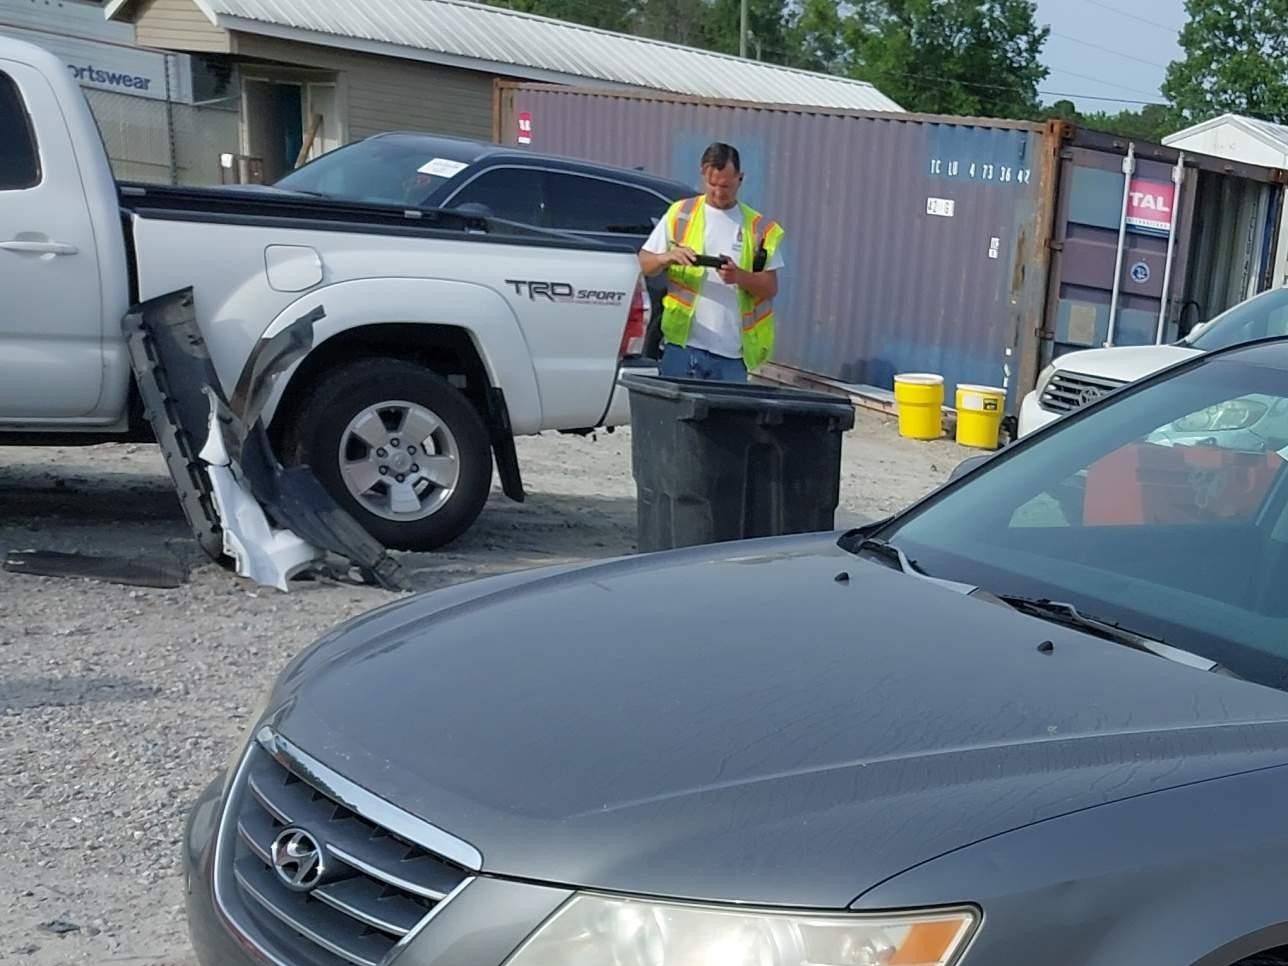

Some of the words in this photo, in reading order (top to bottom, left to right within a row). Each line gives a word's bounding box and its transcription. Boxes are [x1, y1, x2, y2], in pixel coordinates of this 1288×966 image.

[1129, 192, 1170, 212] TAL
[505, 280, 573, 302] TRD
[576, 290, 626, 301] SPORT
